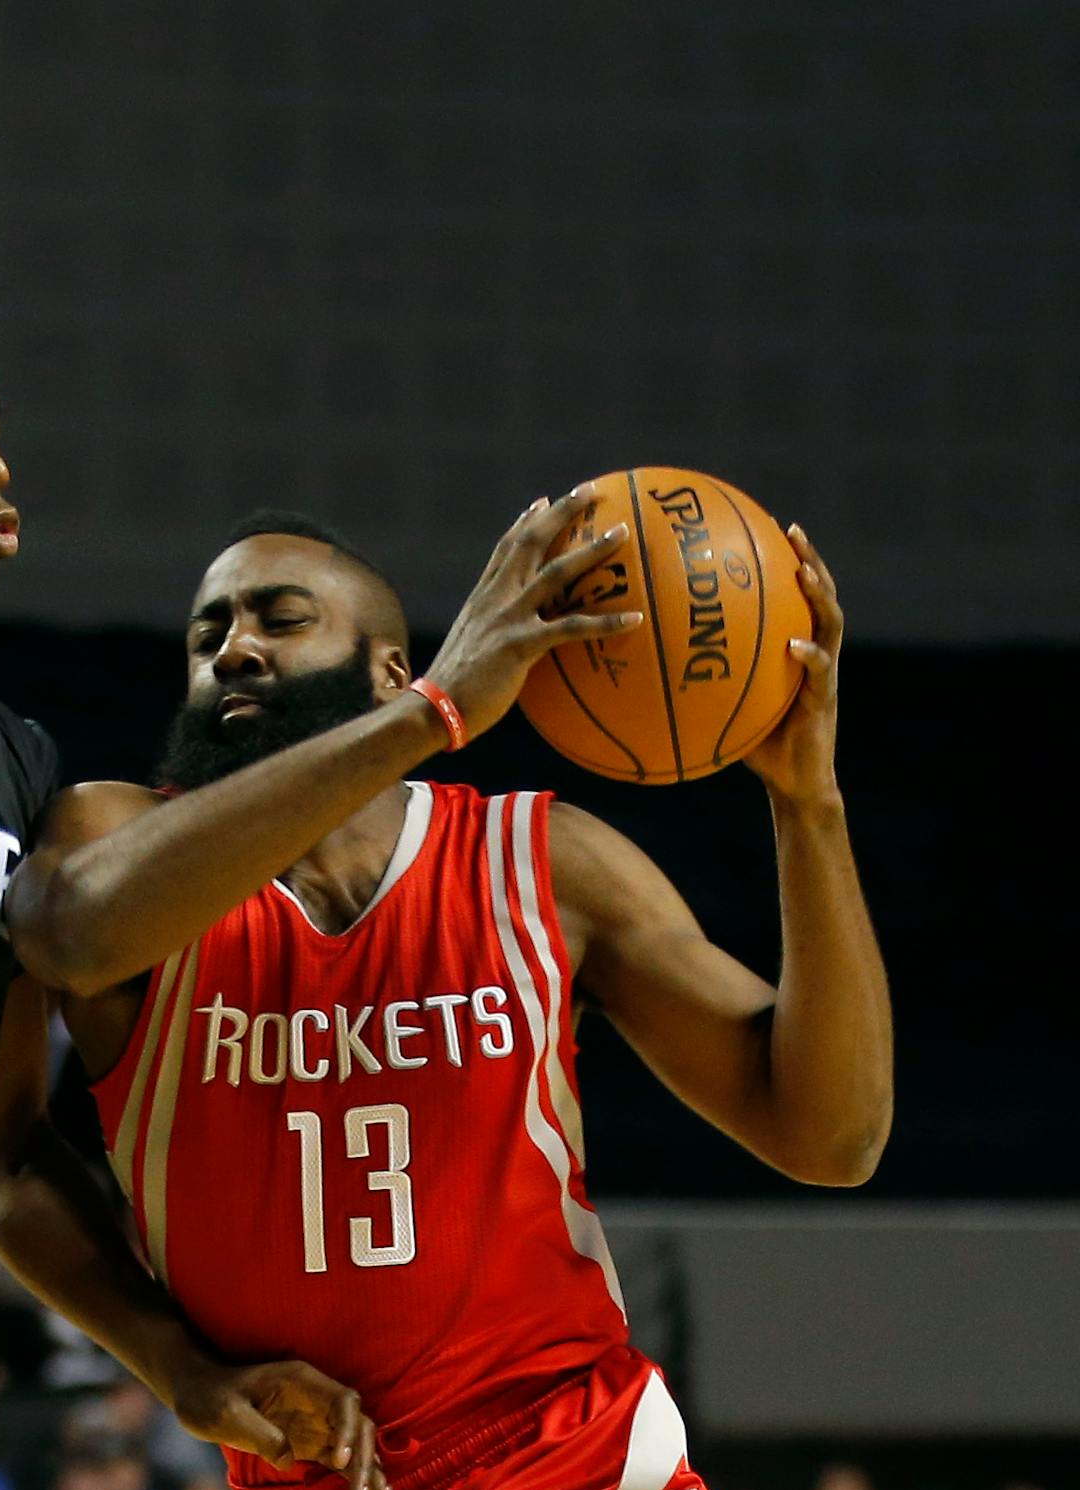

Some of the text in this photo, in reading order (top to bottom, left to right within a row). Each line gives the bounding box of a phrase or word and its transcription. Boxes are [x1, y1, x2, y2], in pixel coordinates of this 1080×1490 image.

[648, 486, 731, 683] SPALDING
[194, 986, 515, 1088] ROCKETS
[287, 1103, 416, 1273] 13
